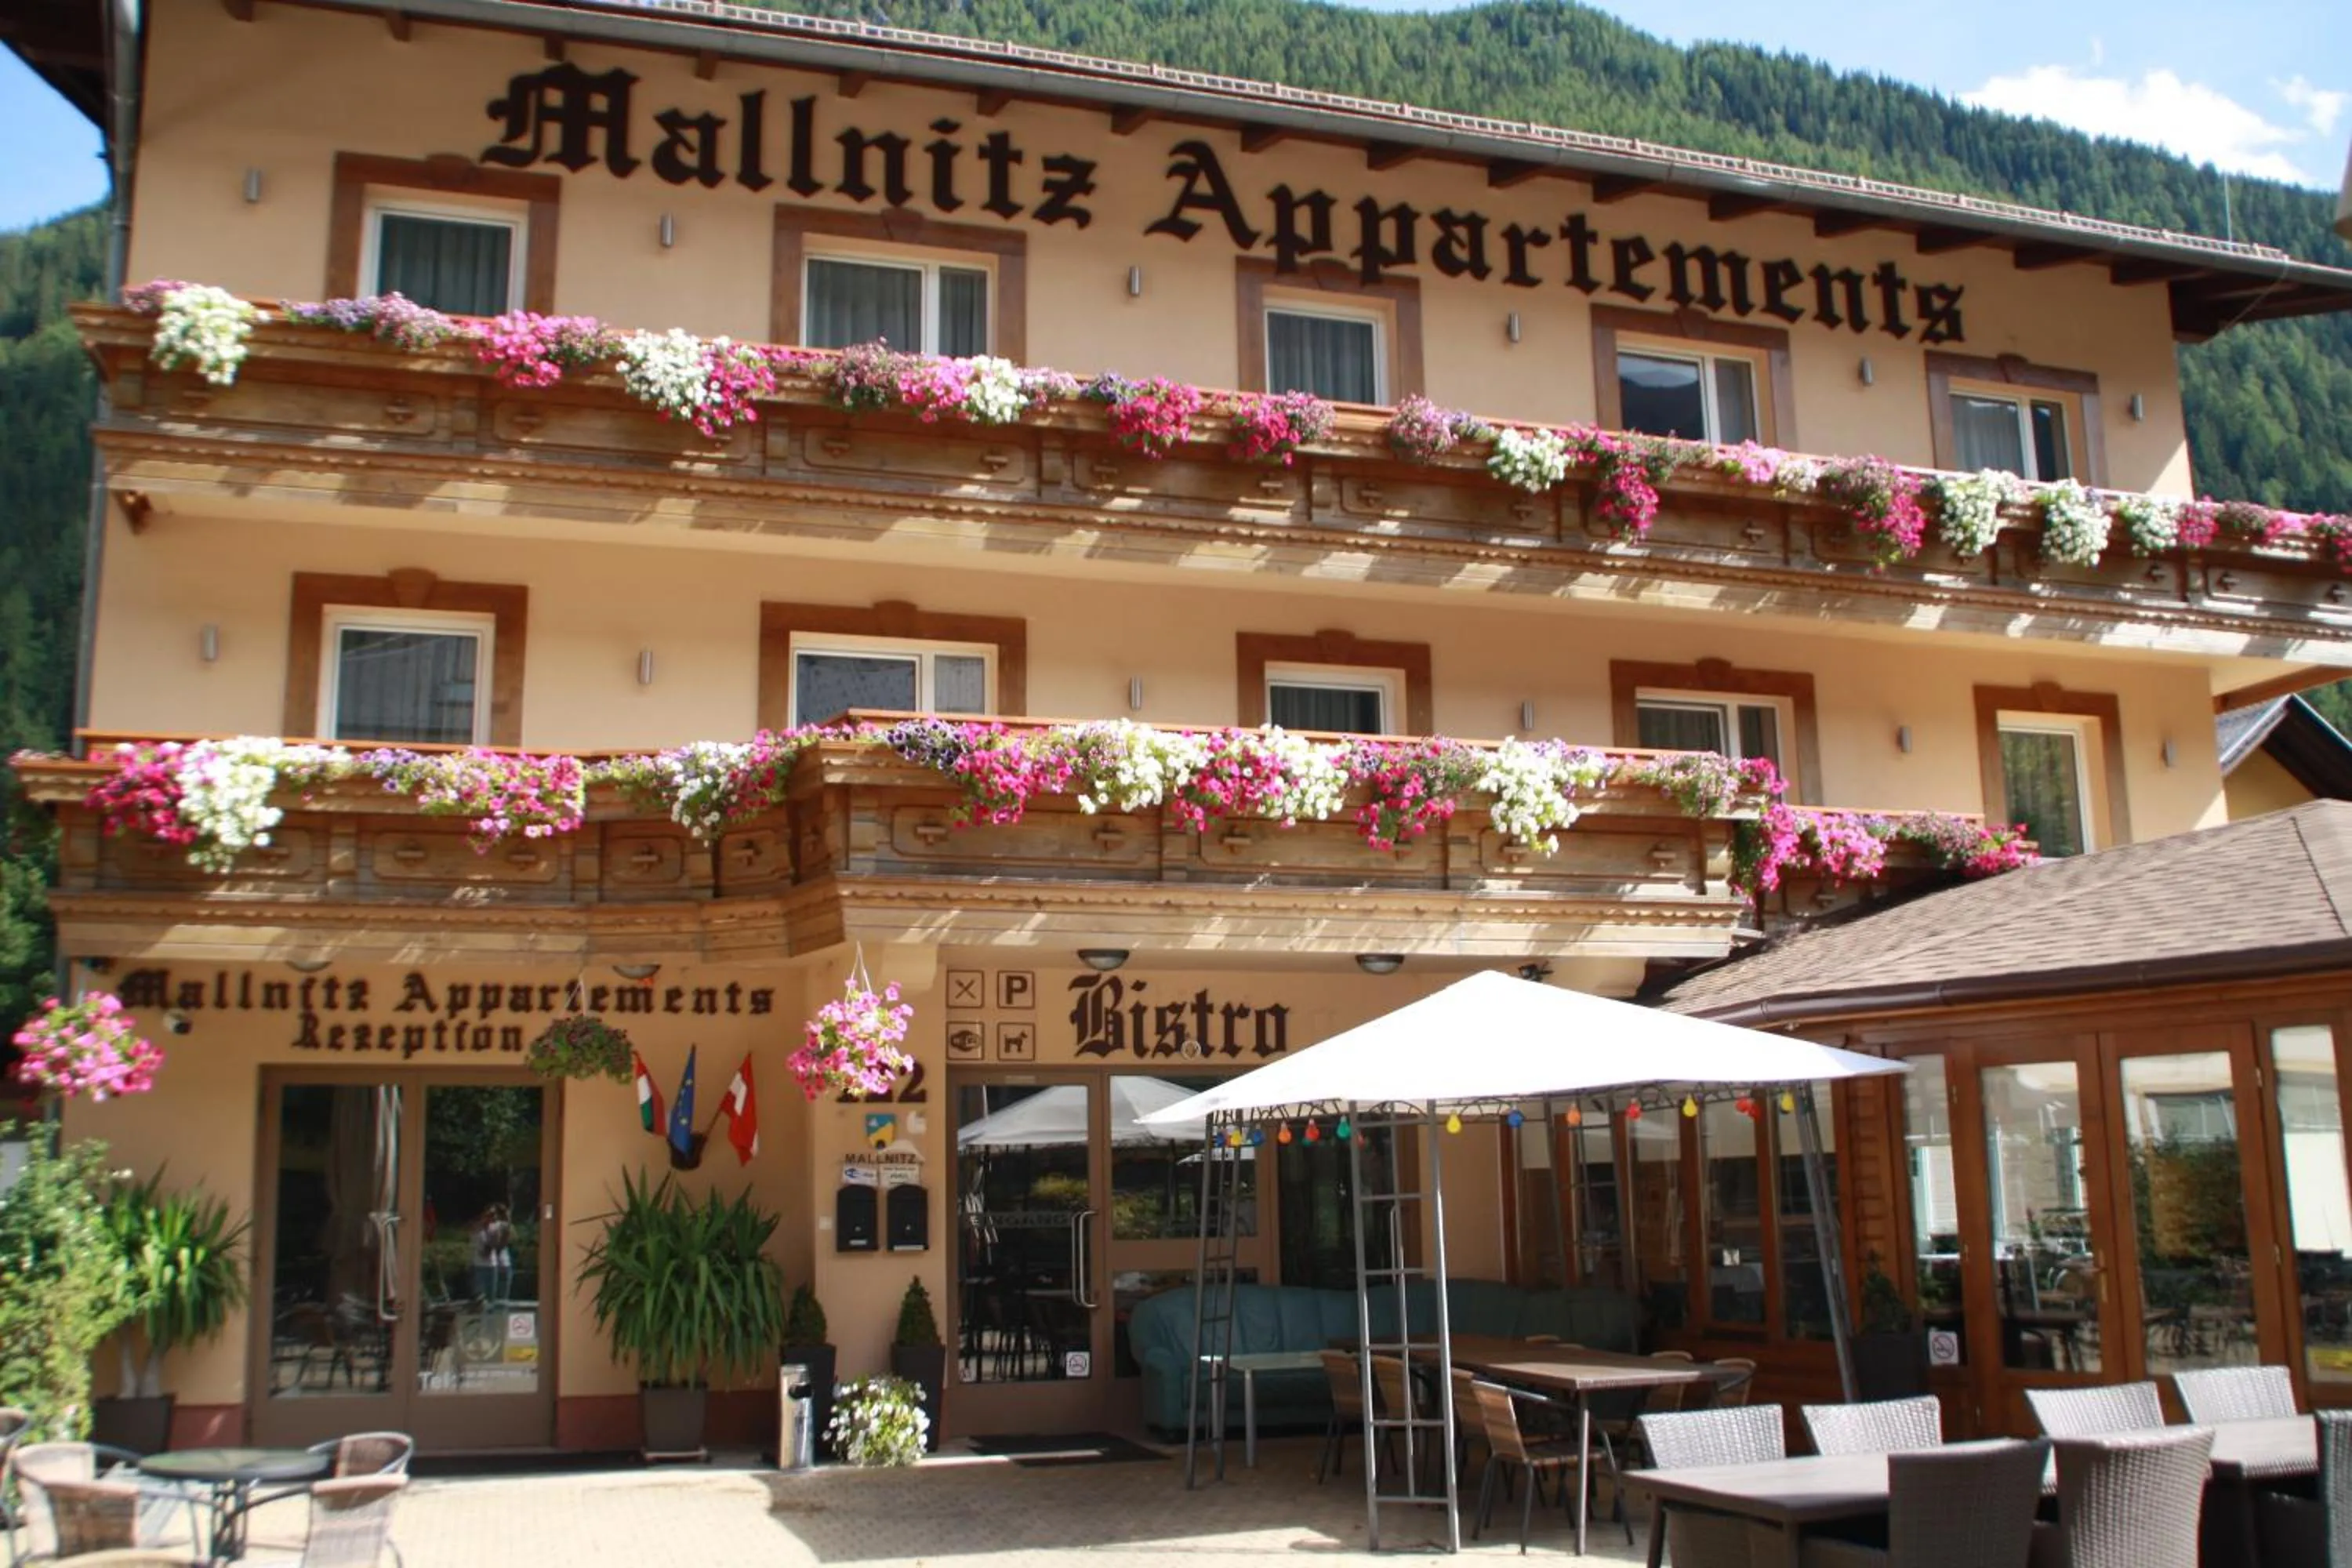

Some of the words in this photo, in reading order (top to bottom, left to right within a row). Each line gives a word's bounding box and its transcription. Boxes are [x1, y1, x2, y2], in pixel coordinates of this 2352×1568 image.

[480, 61, 1098, 229] Mallnitz
[1145, 140, 1966, 345] Appartements
[118, 970, 368, 1010] Mallnitz
[393, 971, 775, 1020] Appartements
[1006, 975, 1028, 1005] P
[292, 1011, 523, 1059] Rezeption
[1067, 974, 1290, 1058] Bistro
[845, 1153, 916, 1164] MALLNITZ
